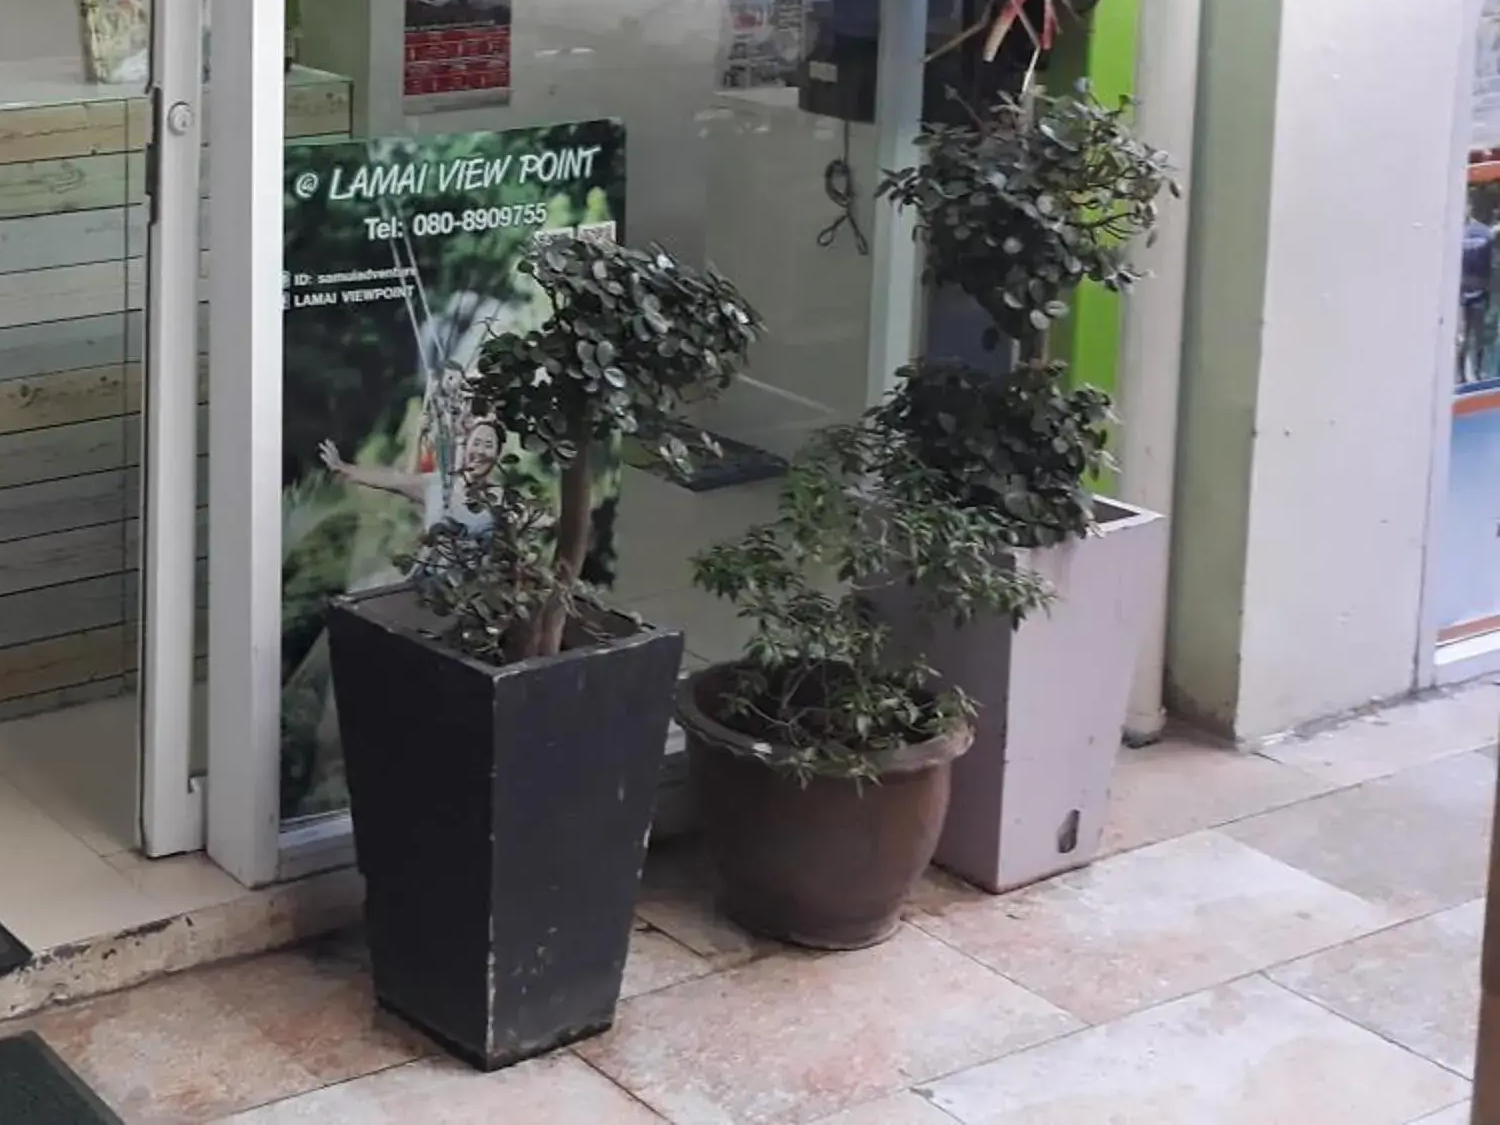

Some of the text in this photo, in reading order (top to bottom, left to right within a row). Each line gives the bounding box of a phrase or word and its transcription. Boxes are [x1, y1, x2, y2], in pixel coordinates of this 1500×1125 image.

[328, 163, 426, 200] LAMAI
[438, 153, 513, 191] VIEW
[519, 145, 601, 183] POINT
[364, 202, 547, 241] Tel: 080-8909755
[294, 285, 415, 308] LAMAI VIEWPOINT
